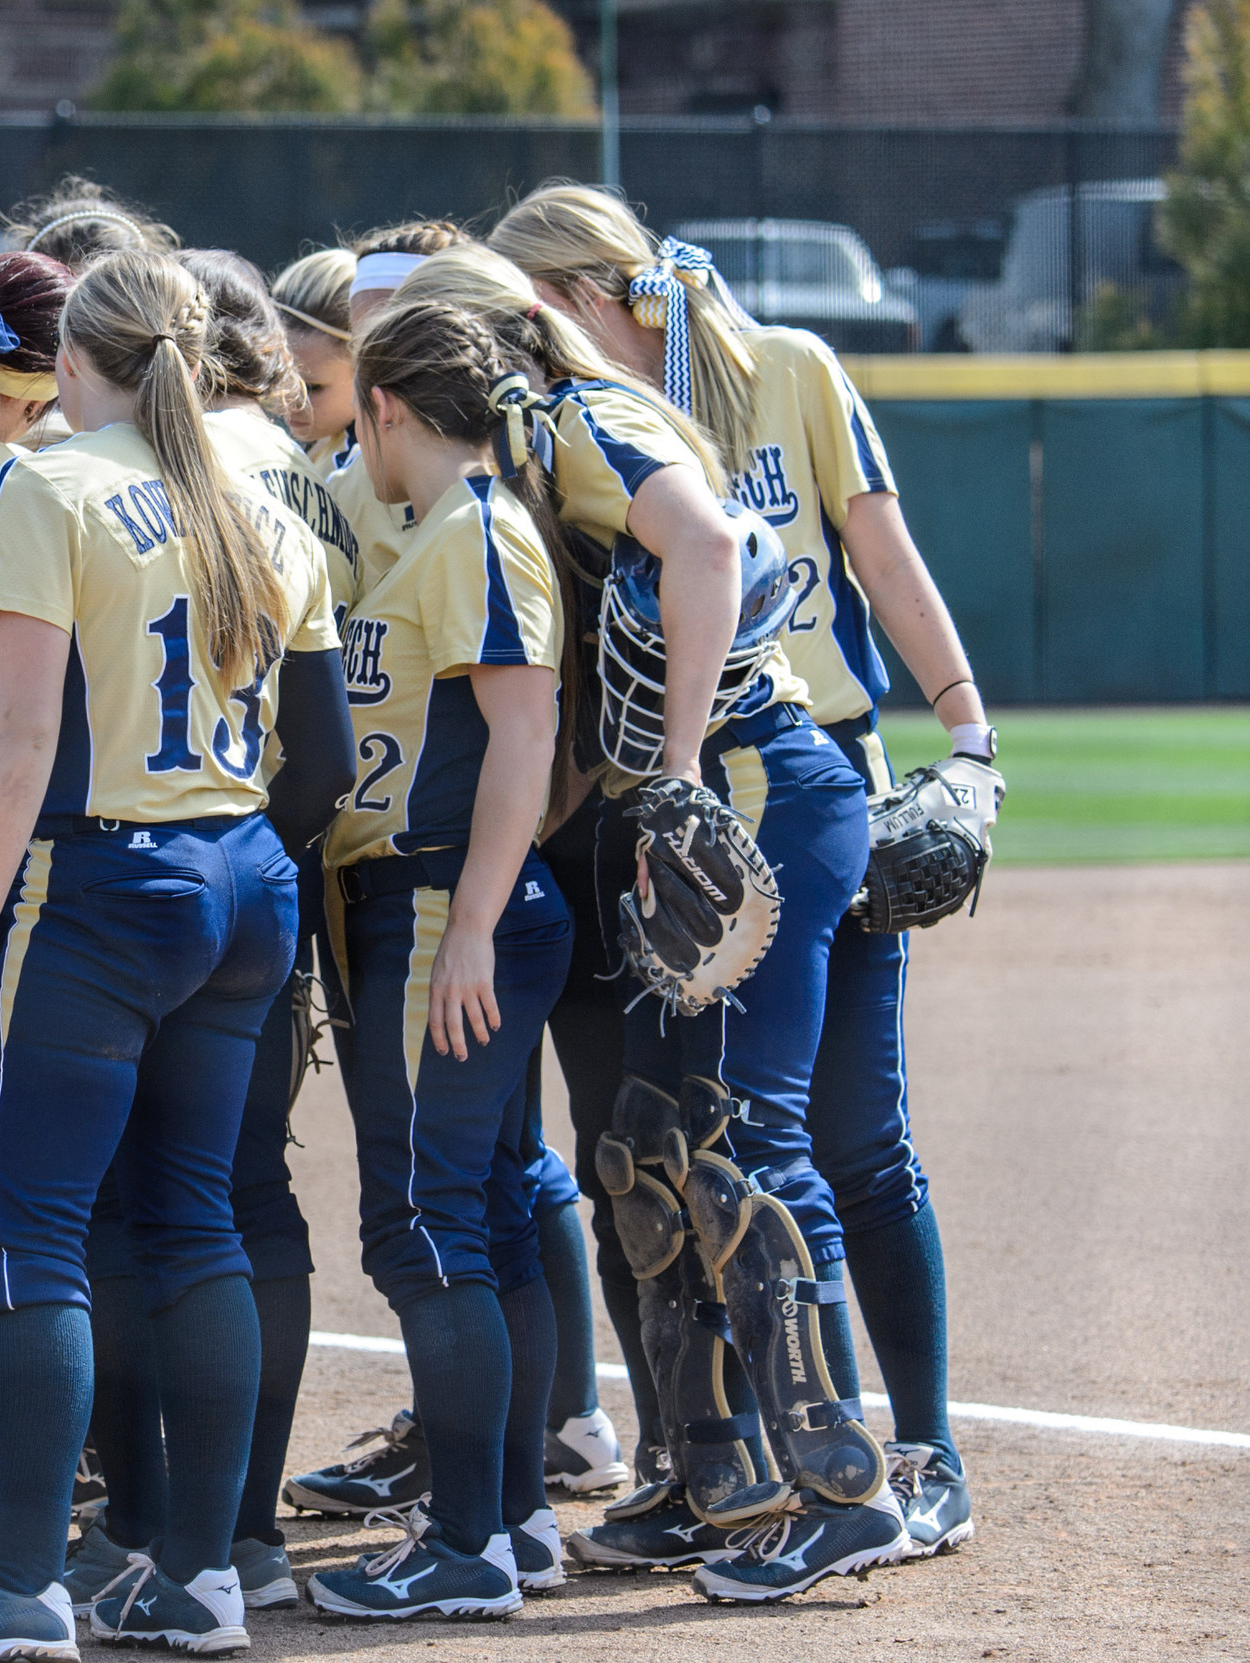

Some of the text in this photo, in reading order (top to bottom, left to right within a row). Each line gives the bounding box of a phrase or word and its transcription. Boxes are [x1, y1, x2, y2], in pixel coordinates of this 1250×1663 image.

[354, 731, 406, 813] 2
[883, 803, 925, 833] FULLUM
[784, 1318, 807, 1383] WORTH
